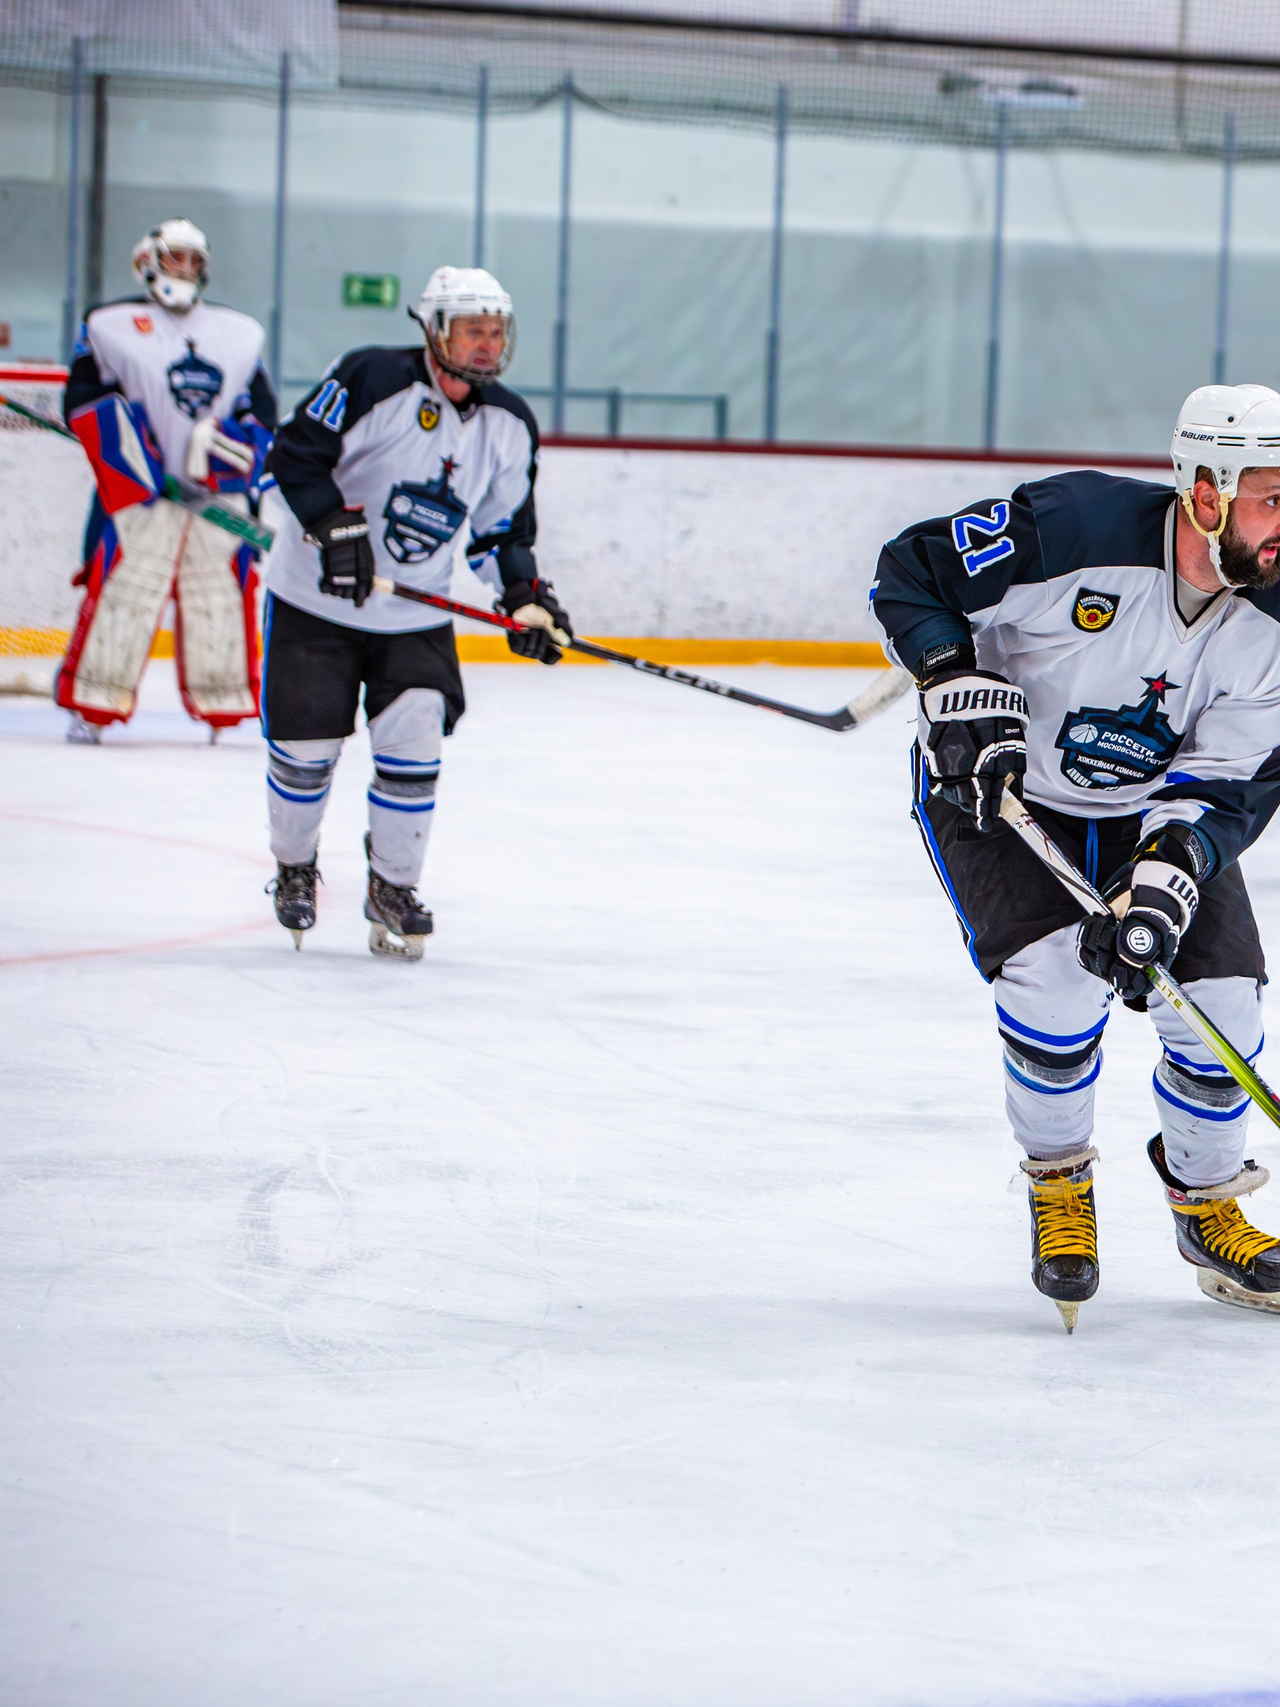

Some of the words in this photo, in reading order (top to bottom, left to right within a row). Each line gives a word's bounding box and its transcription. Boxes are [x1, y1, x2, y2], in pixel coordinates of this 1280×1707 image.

[305, 379, 350, 433] 11
[1180, 430, 1215, 442] BAUER
[951, 501, 1015, 578] 21
[1097, 741, 1145, 760] МОСКОВСКИЙ
[1101, 731, 1155, 757] РОССЕТИ
[1077, 755, 1115, 771] ХОККЕЙНАЯ
